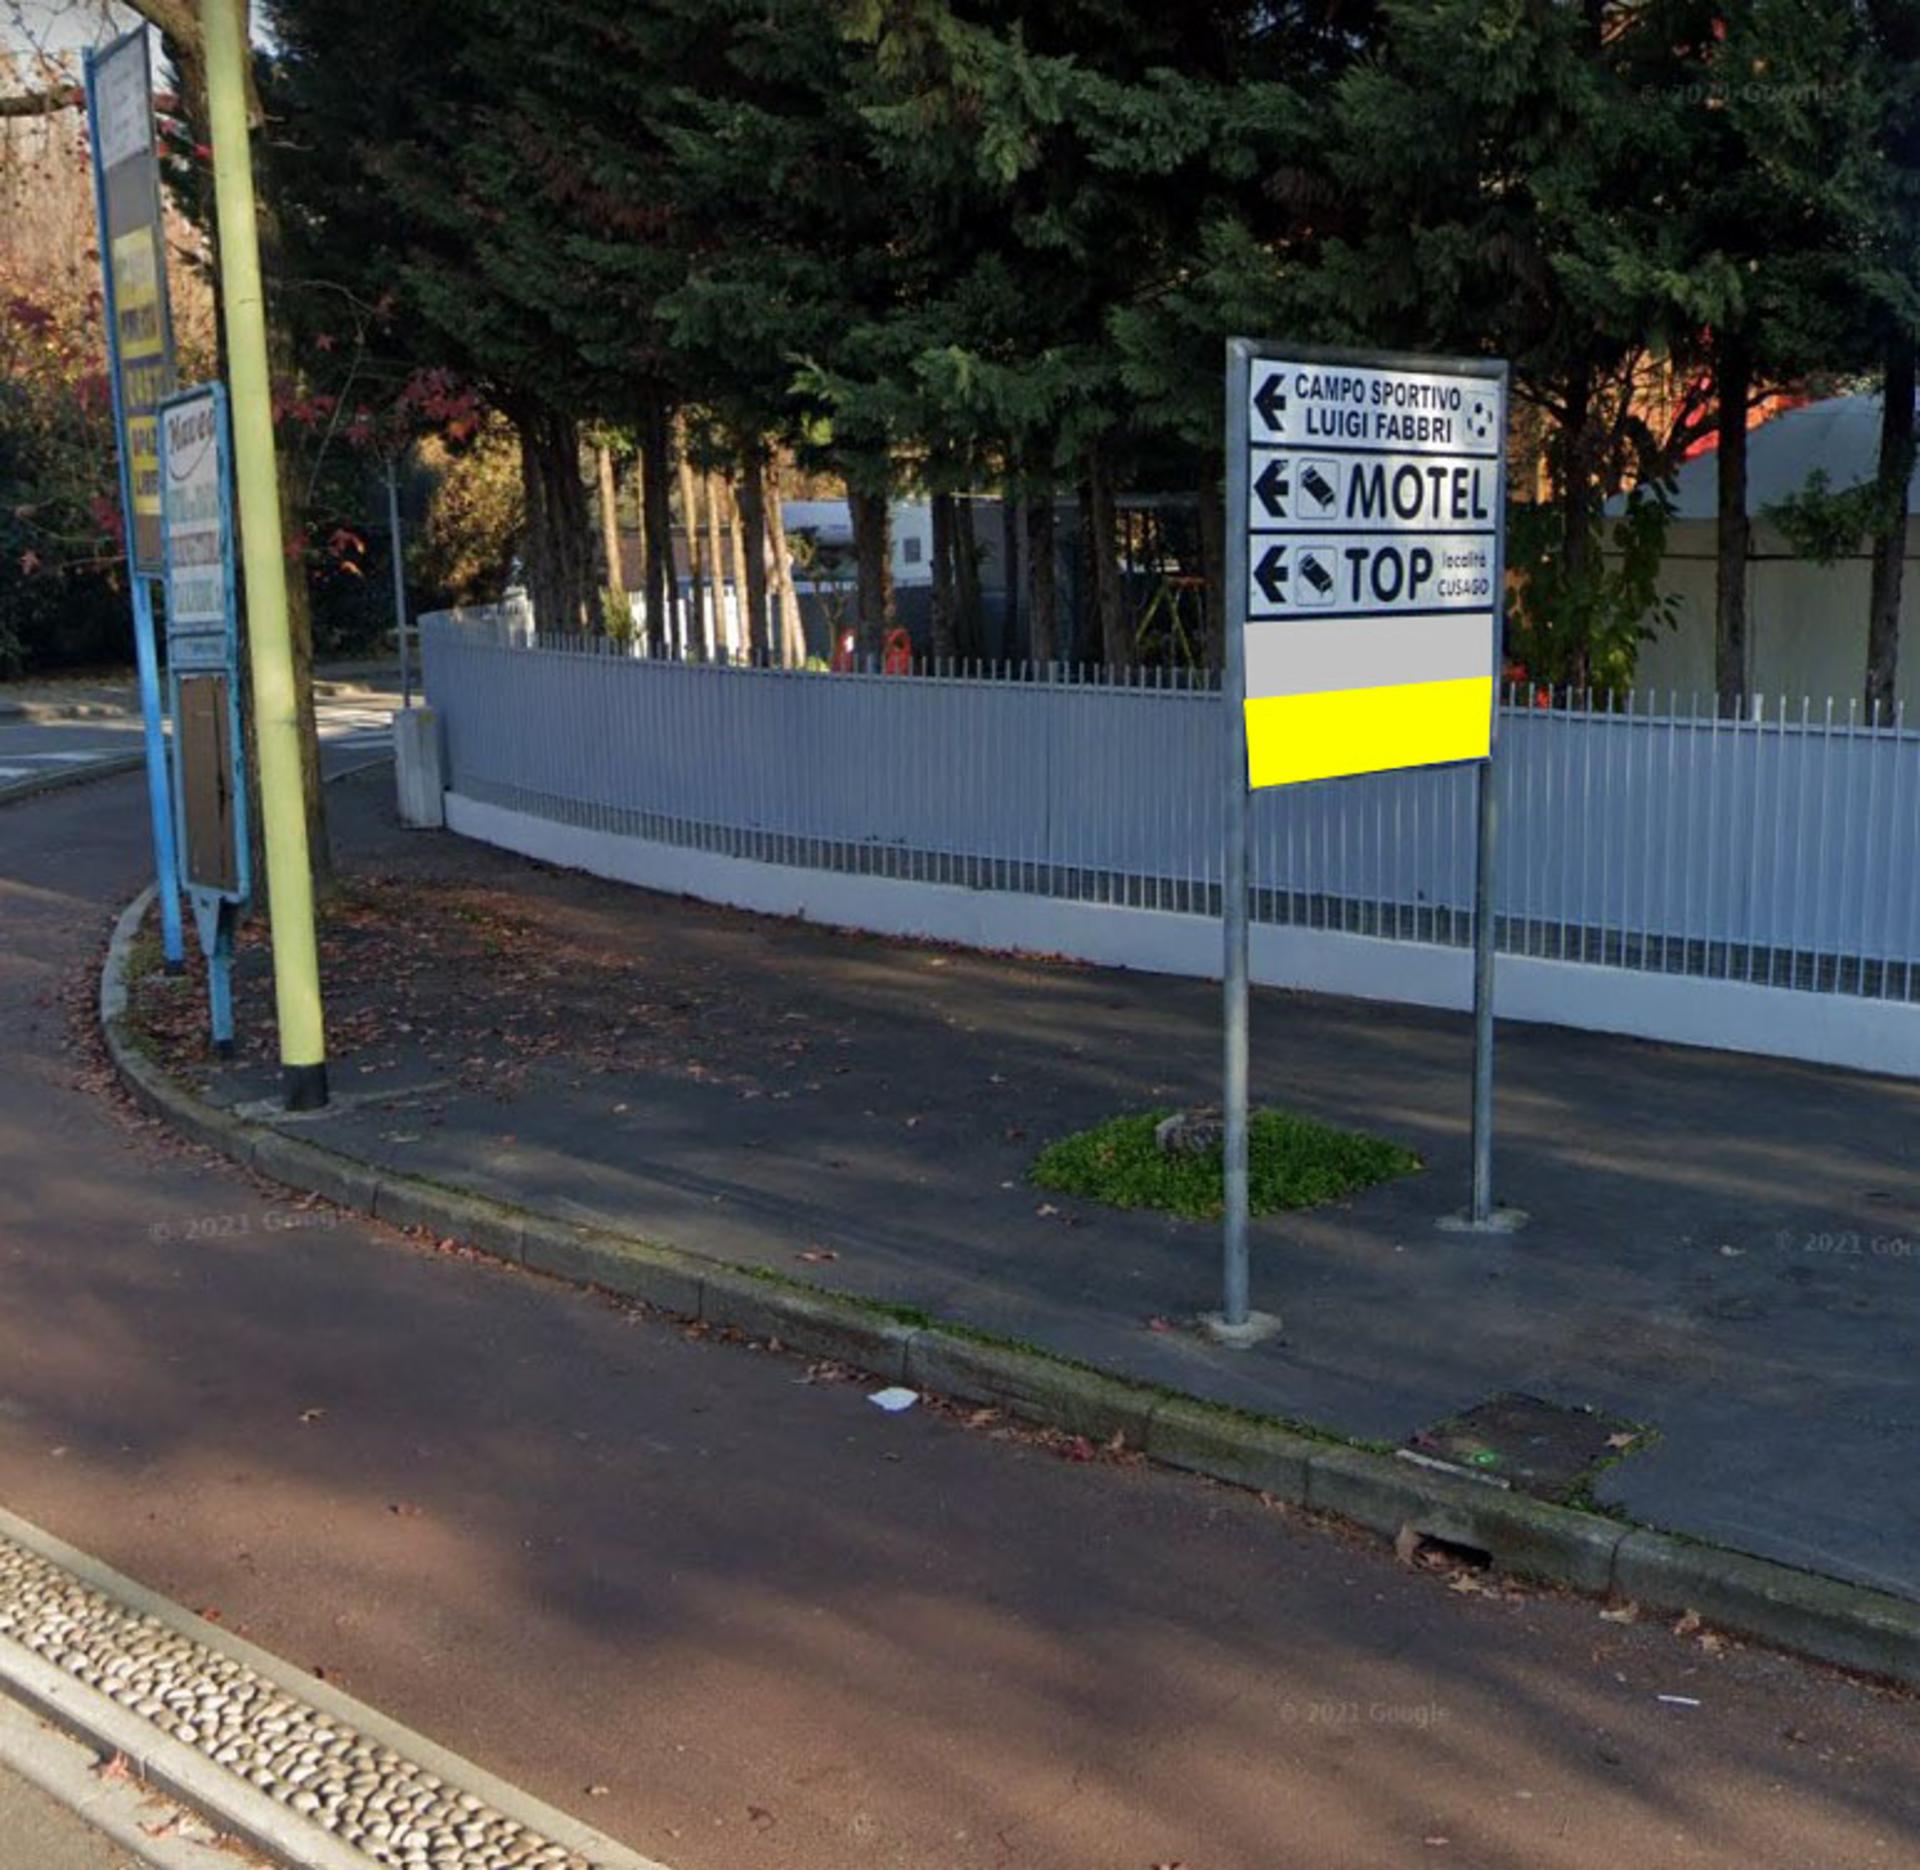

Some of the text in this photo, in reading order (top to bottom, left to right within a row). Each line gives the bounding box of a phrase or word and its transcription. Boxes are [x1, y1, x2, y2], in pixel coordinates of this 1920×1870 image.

[1295, 373, 1461, 411] CAMPO SPORTIVO
[1306, 407, 1452, 443] LUIGI FABBRI
[1346, 462, 1488, 520] MOTEL
[1345, 547, 1433, 602] TOP
[1437, 577, 1489, 597] CUSAGO
